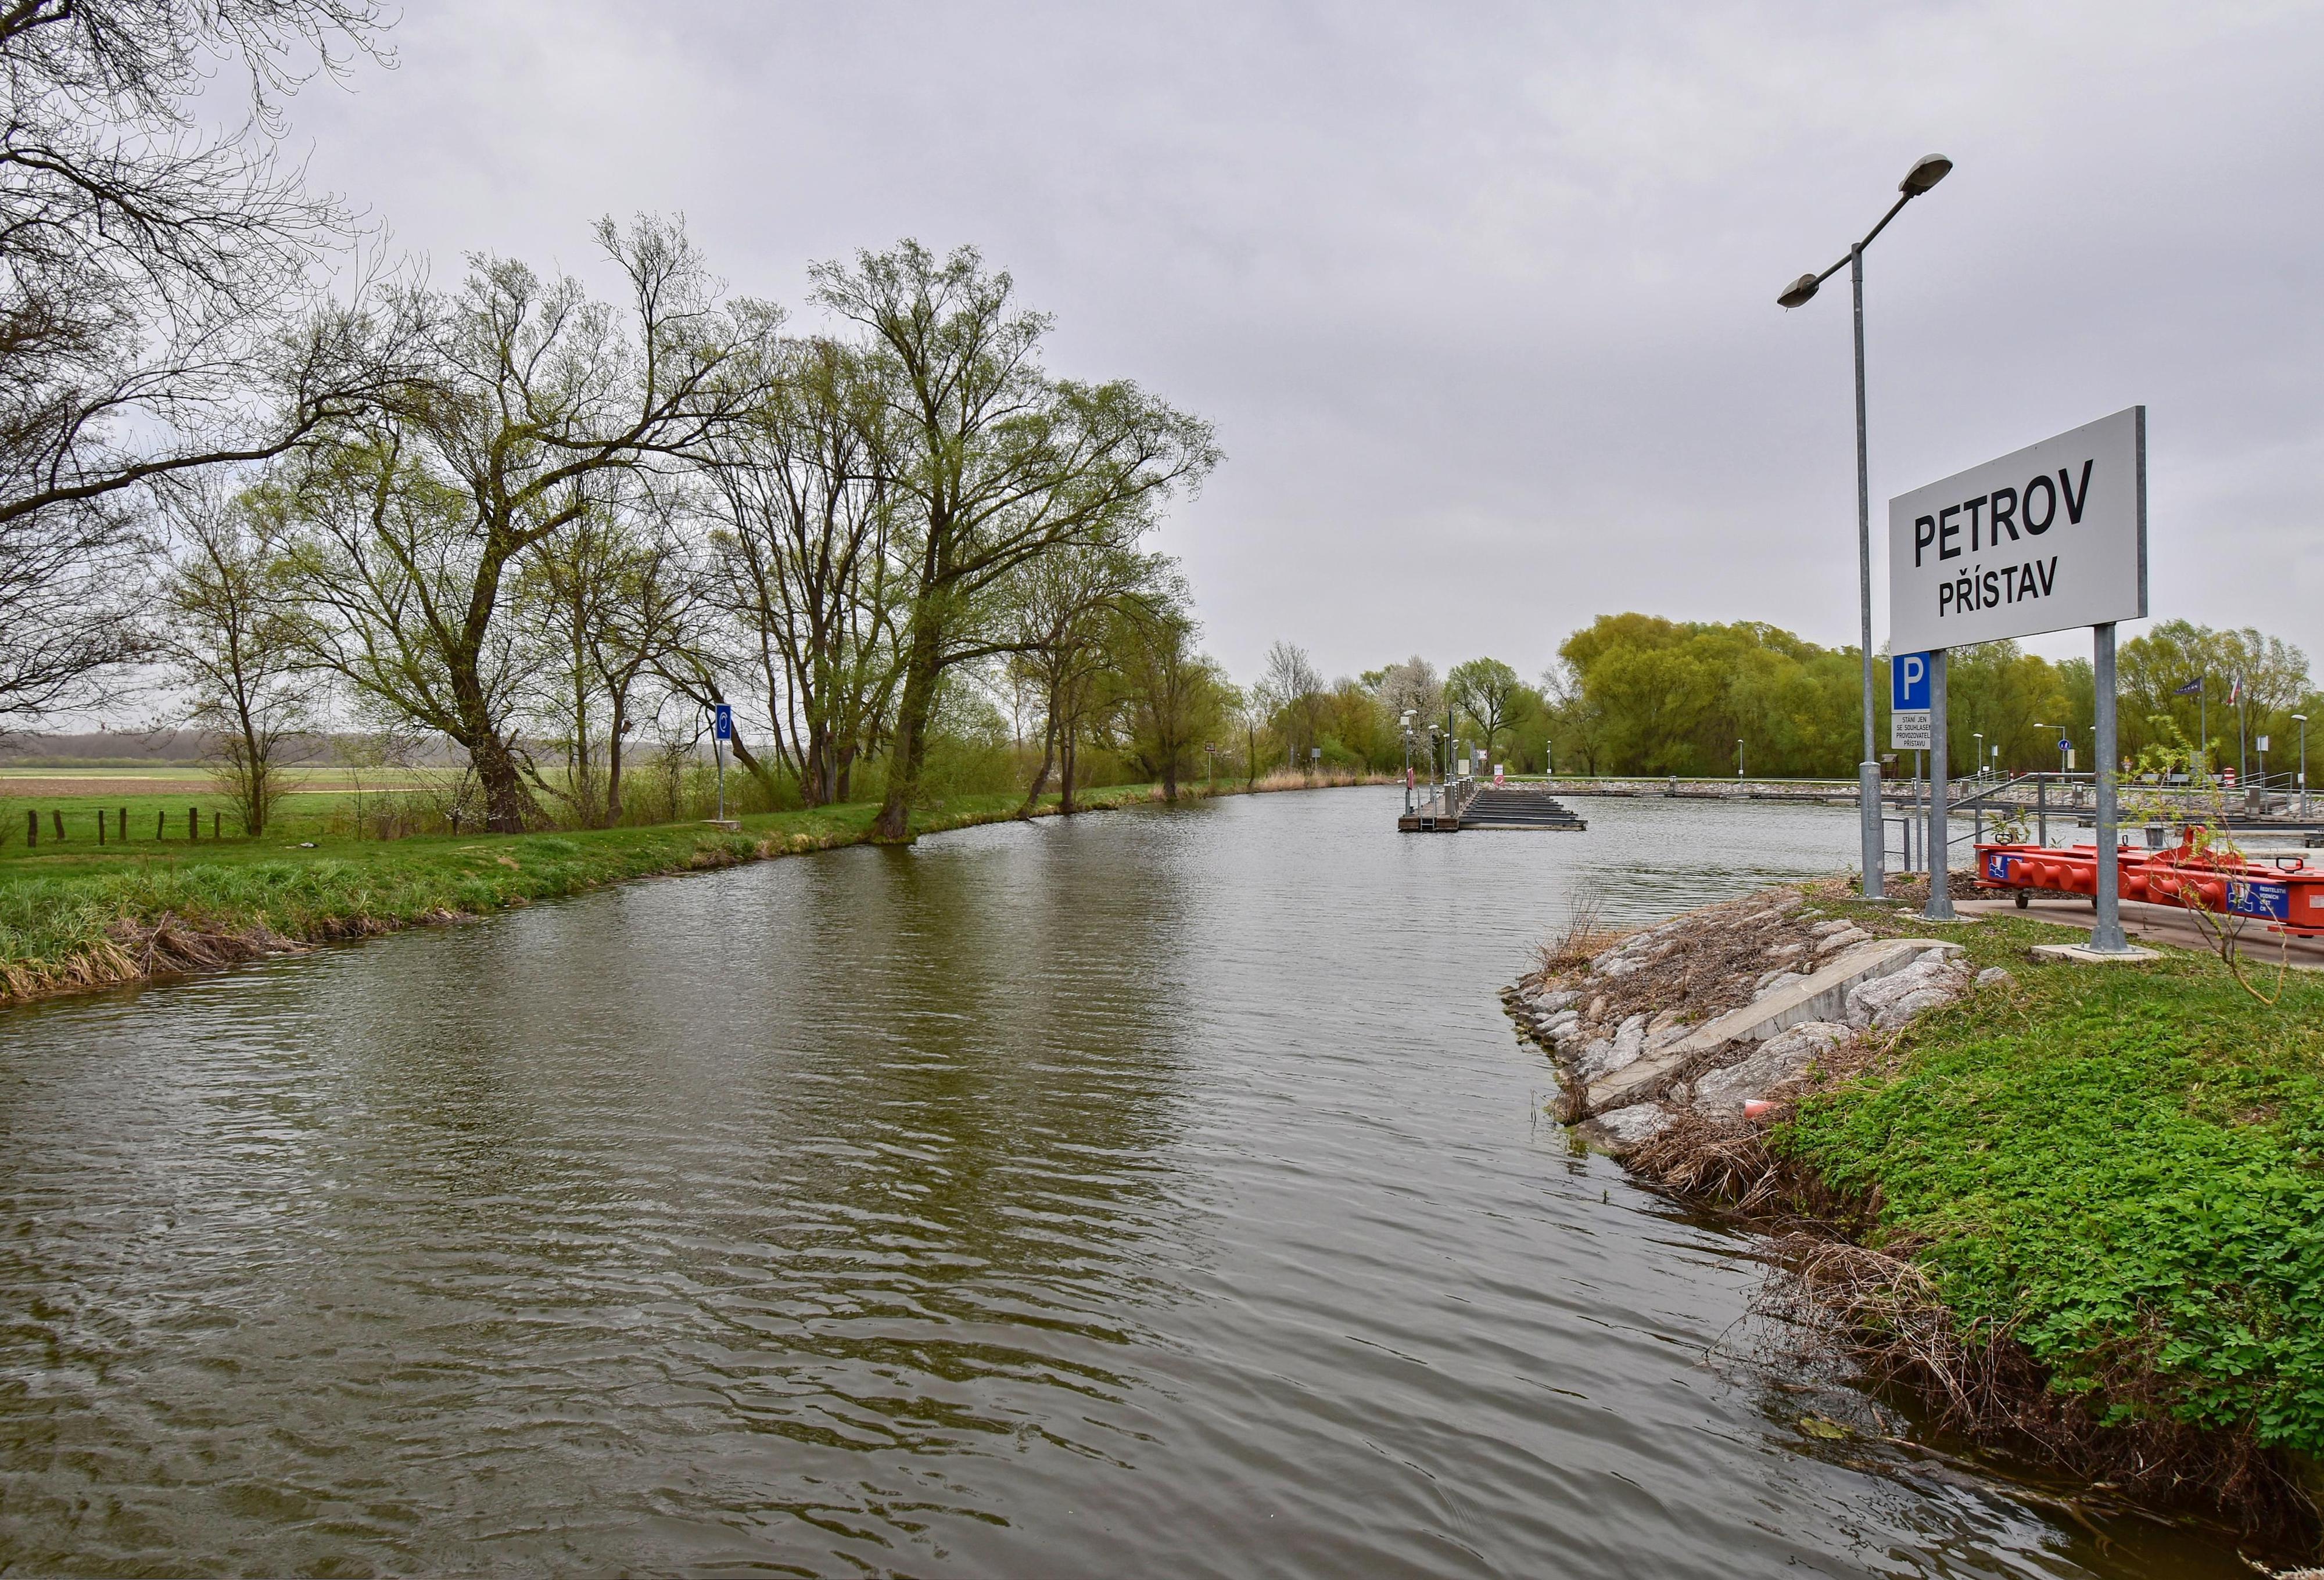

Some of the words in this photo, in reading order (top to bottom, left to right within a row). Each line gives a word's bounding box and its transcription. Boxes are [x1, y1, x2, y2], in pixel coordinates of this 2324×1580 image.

[1915, 458, 2094, 568] PETROV
[1939, 555, 2058, 617] PŘÍSTAV
[1903, 656, 1924, 700] P
